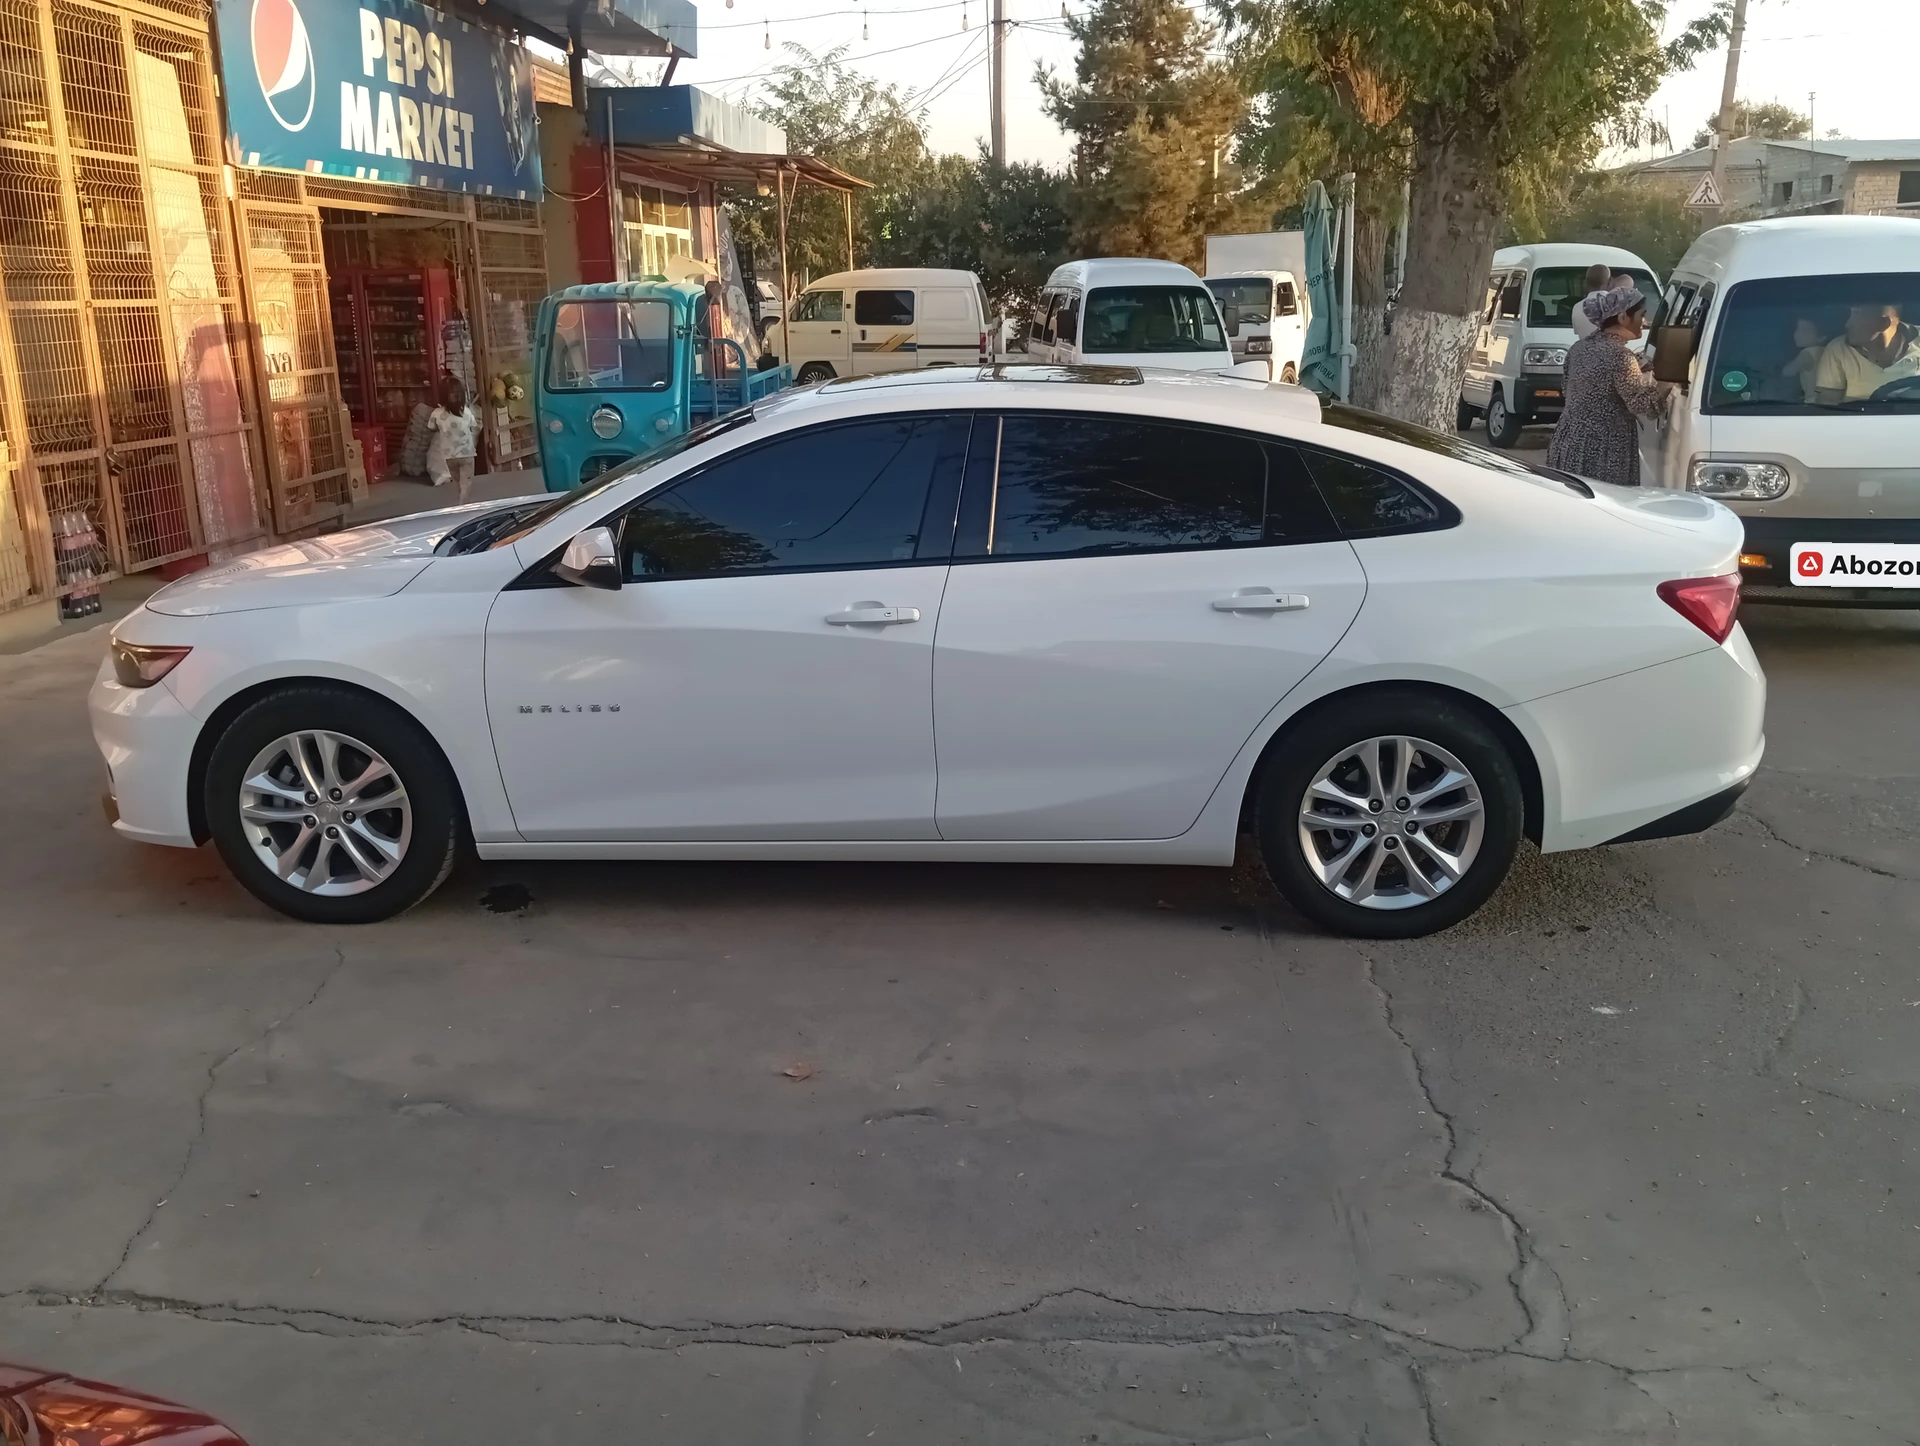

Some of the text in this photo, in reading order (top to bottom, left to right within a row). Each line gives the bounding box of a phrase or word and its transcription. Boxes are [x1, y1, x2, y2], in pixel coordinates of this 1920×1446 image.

[359, 7, 455, 99] PEPSI
[340, 80, 474, 170] MARKET
[519, 703, 621, 714] MALIBU
